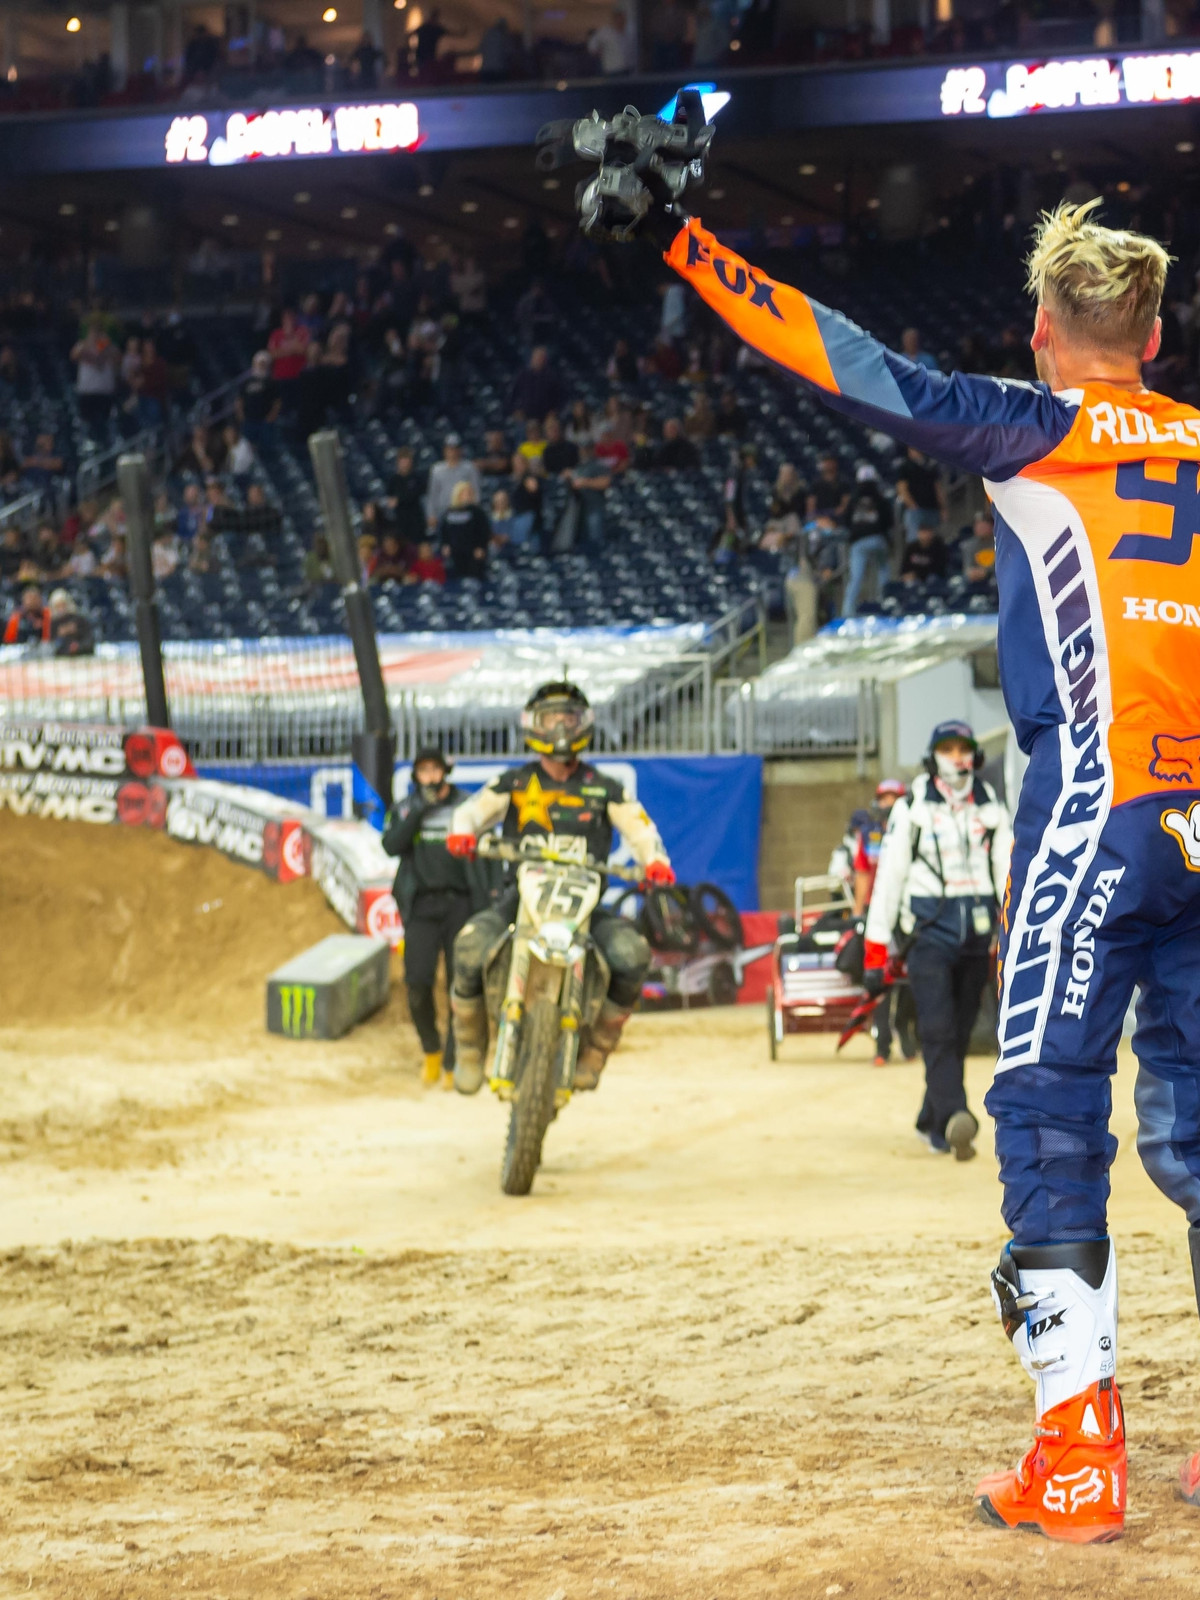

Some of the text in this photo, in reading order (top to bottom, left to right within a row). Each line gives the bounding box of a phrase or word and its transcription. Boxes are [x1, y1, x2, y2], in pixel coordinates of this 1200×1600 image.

[687, 231, 786, 322] FOX
[537, 877, 588, 919] 15
[1016, 838, 1090, 965] FOX
[1060, 865, 1127, 1020] HONDA
[1029, 1307, 1068, 1340] OX
